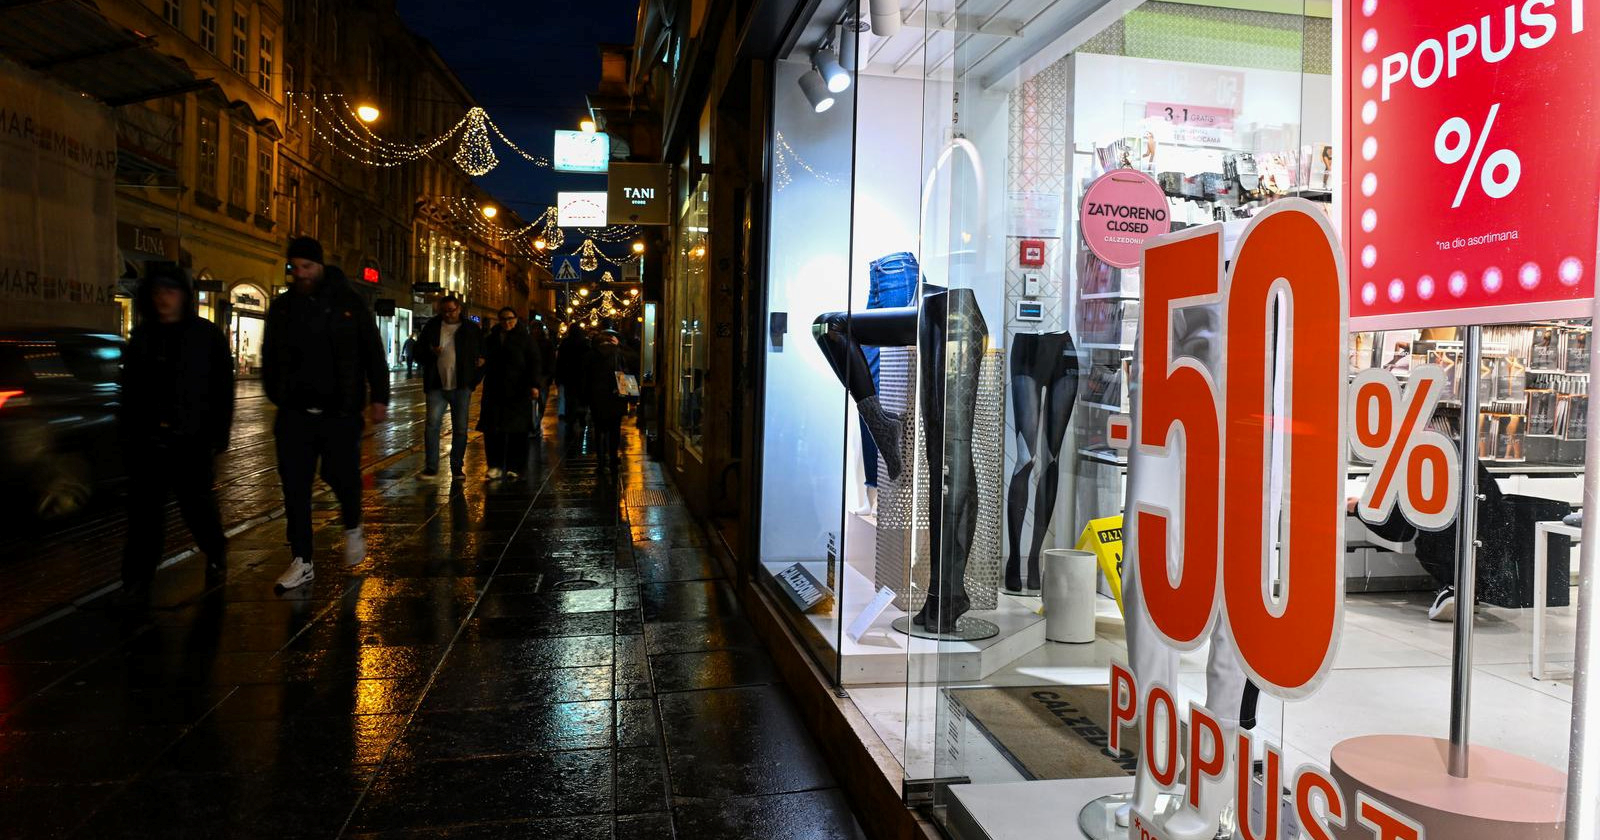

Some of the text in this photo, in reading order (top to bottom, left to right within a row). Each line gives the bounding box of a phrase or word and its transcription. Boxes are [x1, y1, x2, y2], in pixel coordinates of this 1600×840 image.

[1434, 103, 1521, 208] %
[623, 187, 655, 199] TANI
[1088, 202, 1166, 222] ZATVORENO
[1106, 220, 1149, 233] CLOSED
[1452, 237, 1466, 248] dio
[1467, 230, 1518, 246] asortimana
[780, 566, 823, 606] CALZEDONIA
